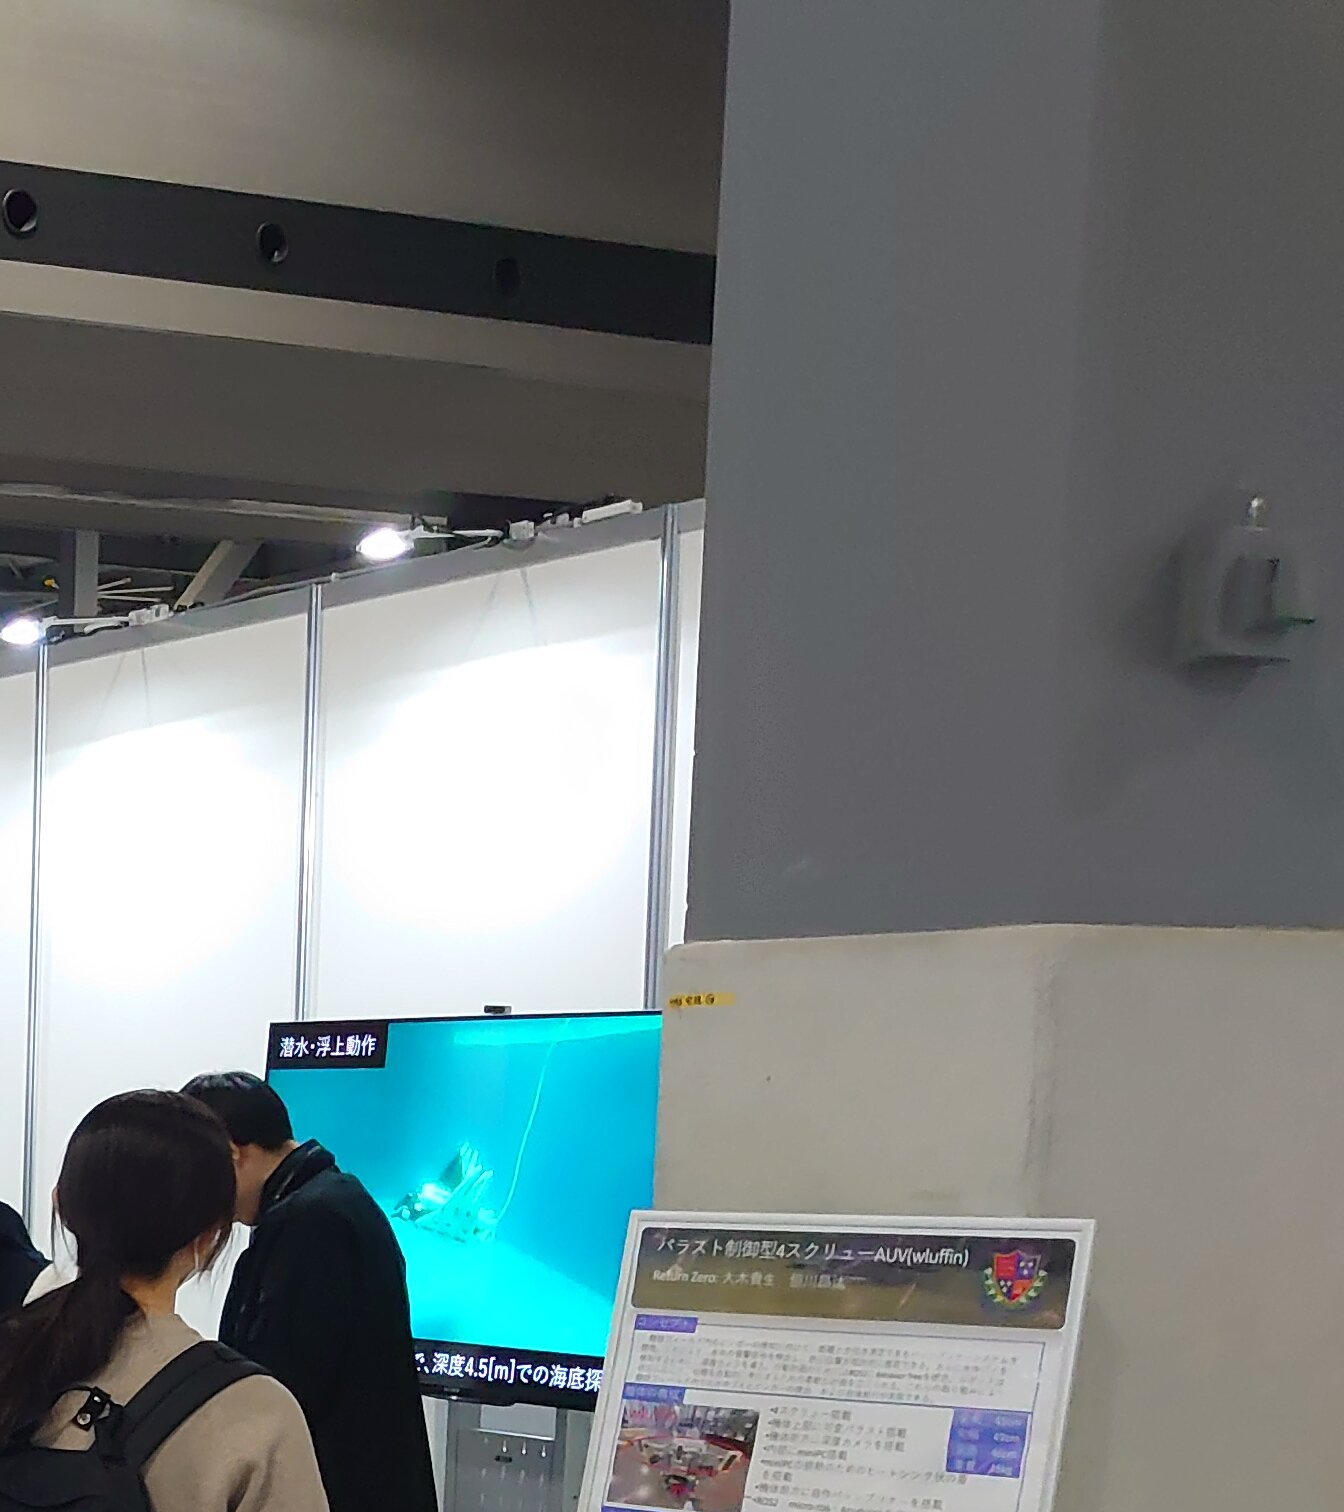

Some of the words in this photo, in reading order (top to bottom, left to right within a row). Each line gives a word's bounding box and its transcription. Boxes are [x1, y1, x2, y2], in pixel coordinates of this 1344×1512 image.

[279, 1033, 377, 1058] 潜水・浮上動作
